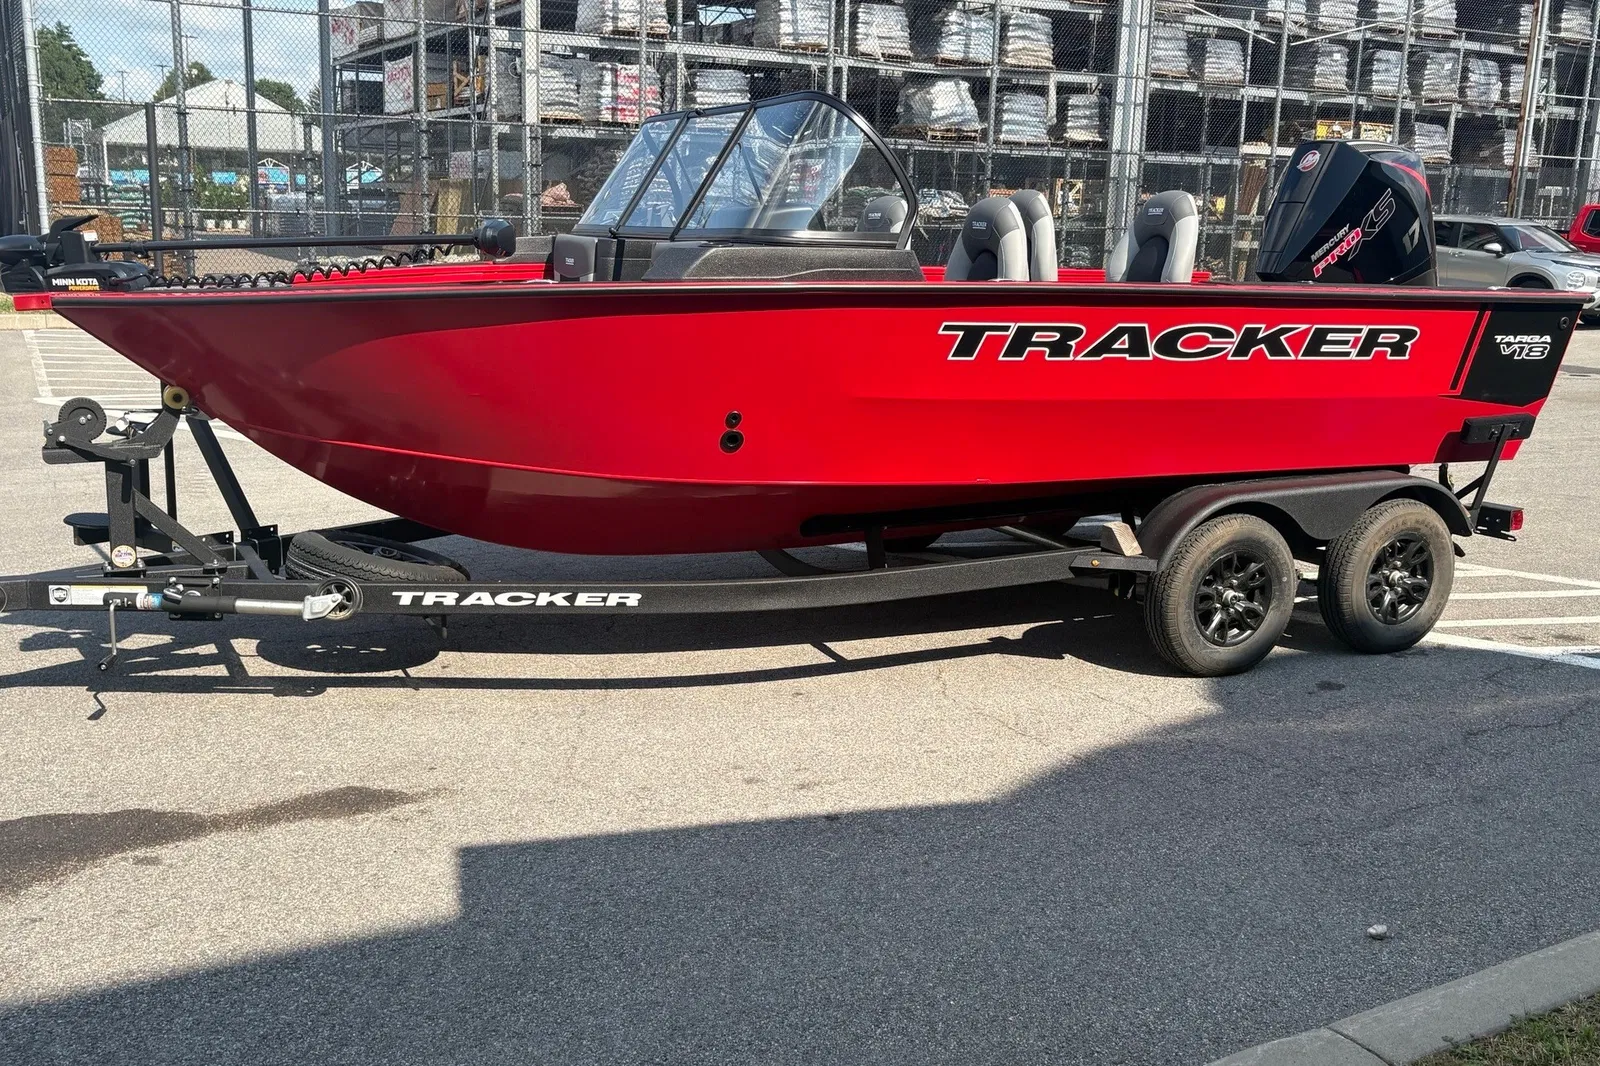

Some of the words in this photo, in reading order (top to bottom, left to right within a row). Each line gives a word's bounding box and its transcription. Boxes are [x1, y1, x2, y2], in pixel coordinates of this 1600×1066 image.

[1310, 223, 1350, 262] MERCURY
[52, 278, 75, 286] MINN
[76, 278, 99, 286] KOTA
[938, 322, 1420, 361] TRACKER
[1494, 335, 1551, 343] TARGA
[1500, 344, 1550, 359] V18
[392, 591, 642, 606] TRACKER
